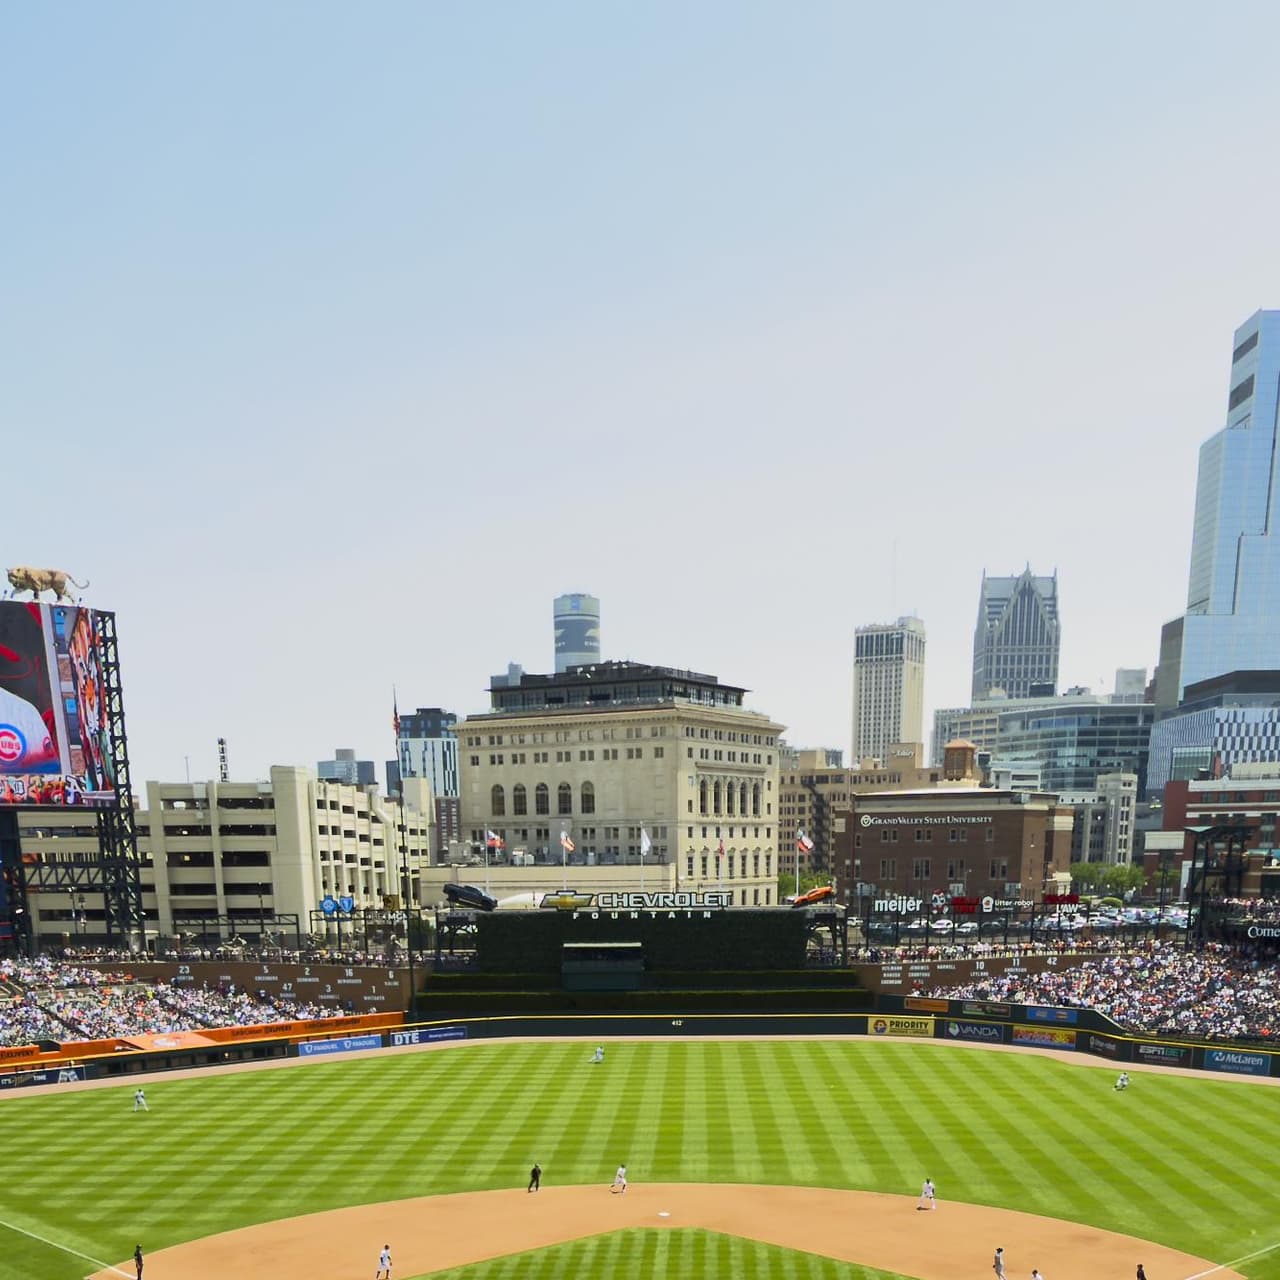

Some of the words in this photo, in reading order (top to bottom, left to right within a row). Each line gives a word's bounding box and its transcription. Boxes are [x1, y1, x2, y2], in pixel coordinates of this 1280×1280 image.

[871, 816, 898, 825] GRAND
[897, 816, 923, 825] VALLEY
[924, 816, 946, 824] STATE
[947, 815, 993, 824] UNIVERSITY
[598, 892, 733, 908] CHEVROLET
[875, 897, 922, 915] meijer
[573, 911, 712, 920] FOUNTAIN
[975, 961, 985, 970] 10
[1047, 958, 1057, 966] 42
[282, 983, 293, 991] 47
[889, 1020, 929, 1030] PRIORITY
[960, 1022, 999, 1037] VANDA
[394, 1032, 419, 1045] DTE
[1226, 1054, 1263, 1066] McLaren
